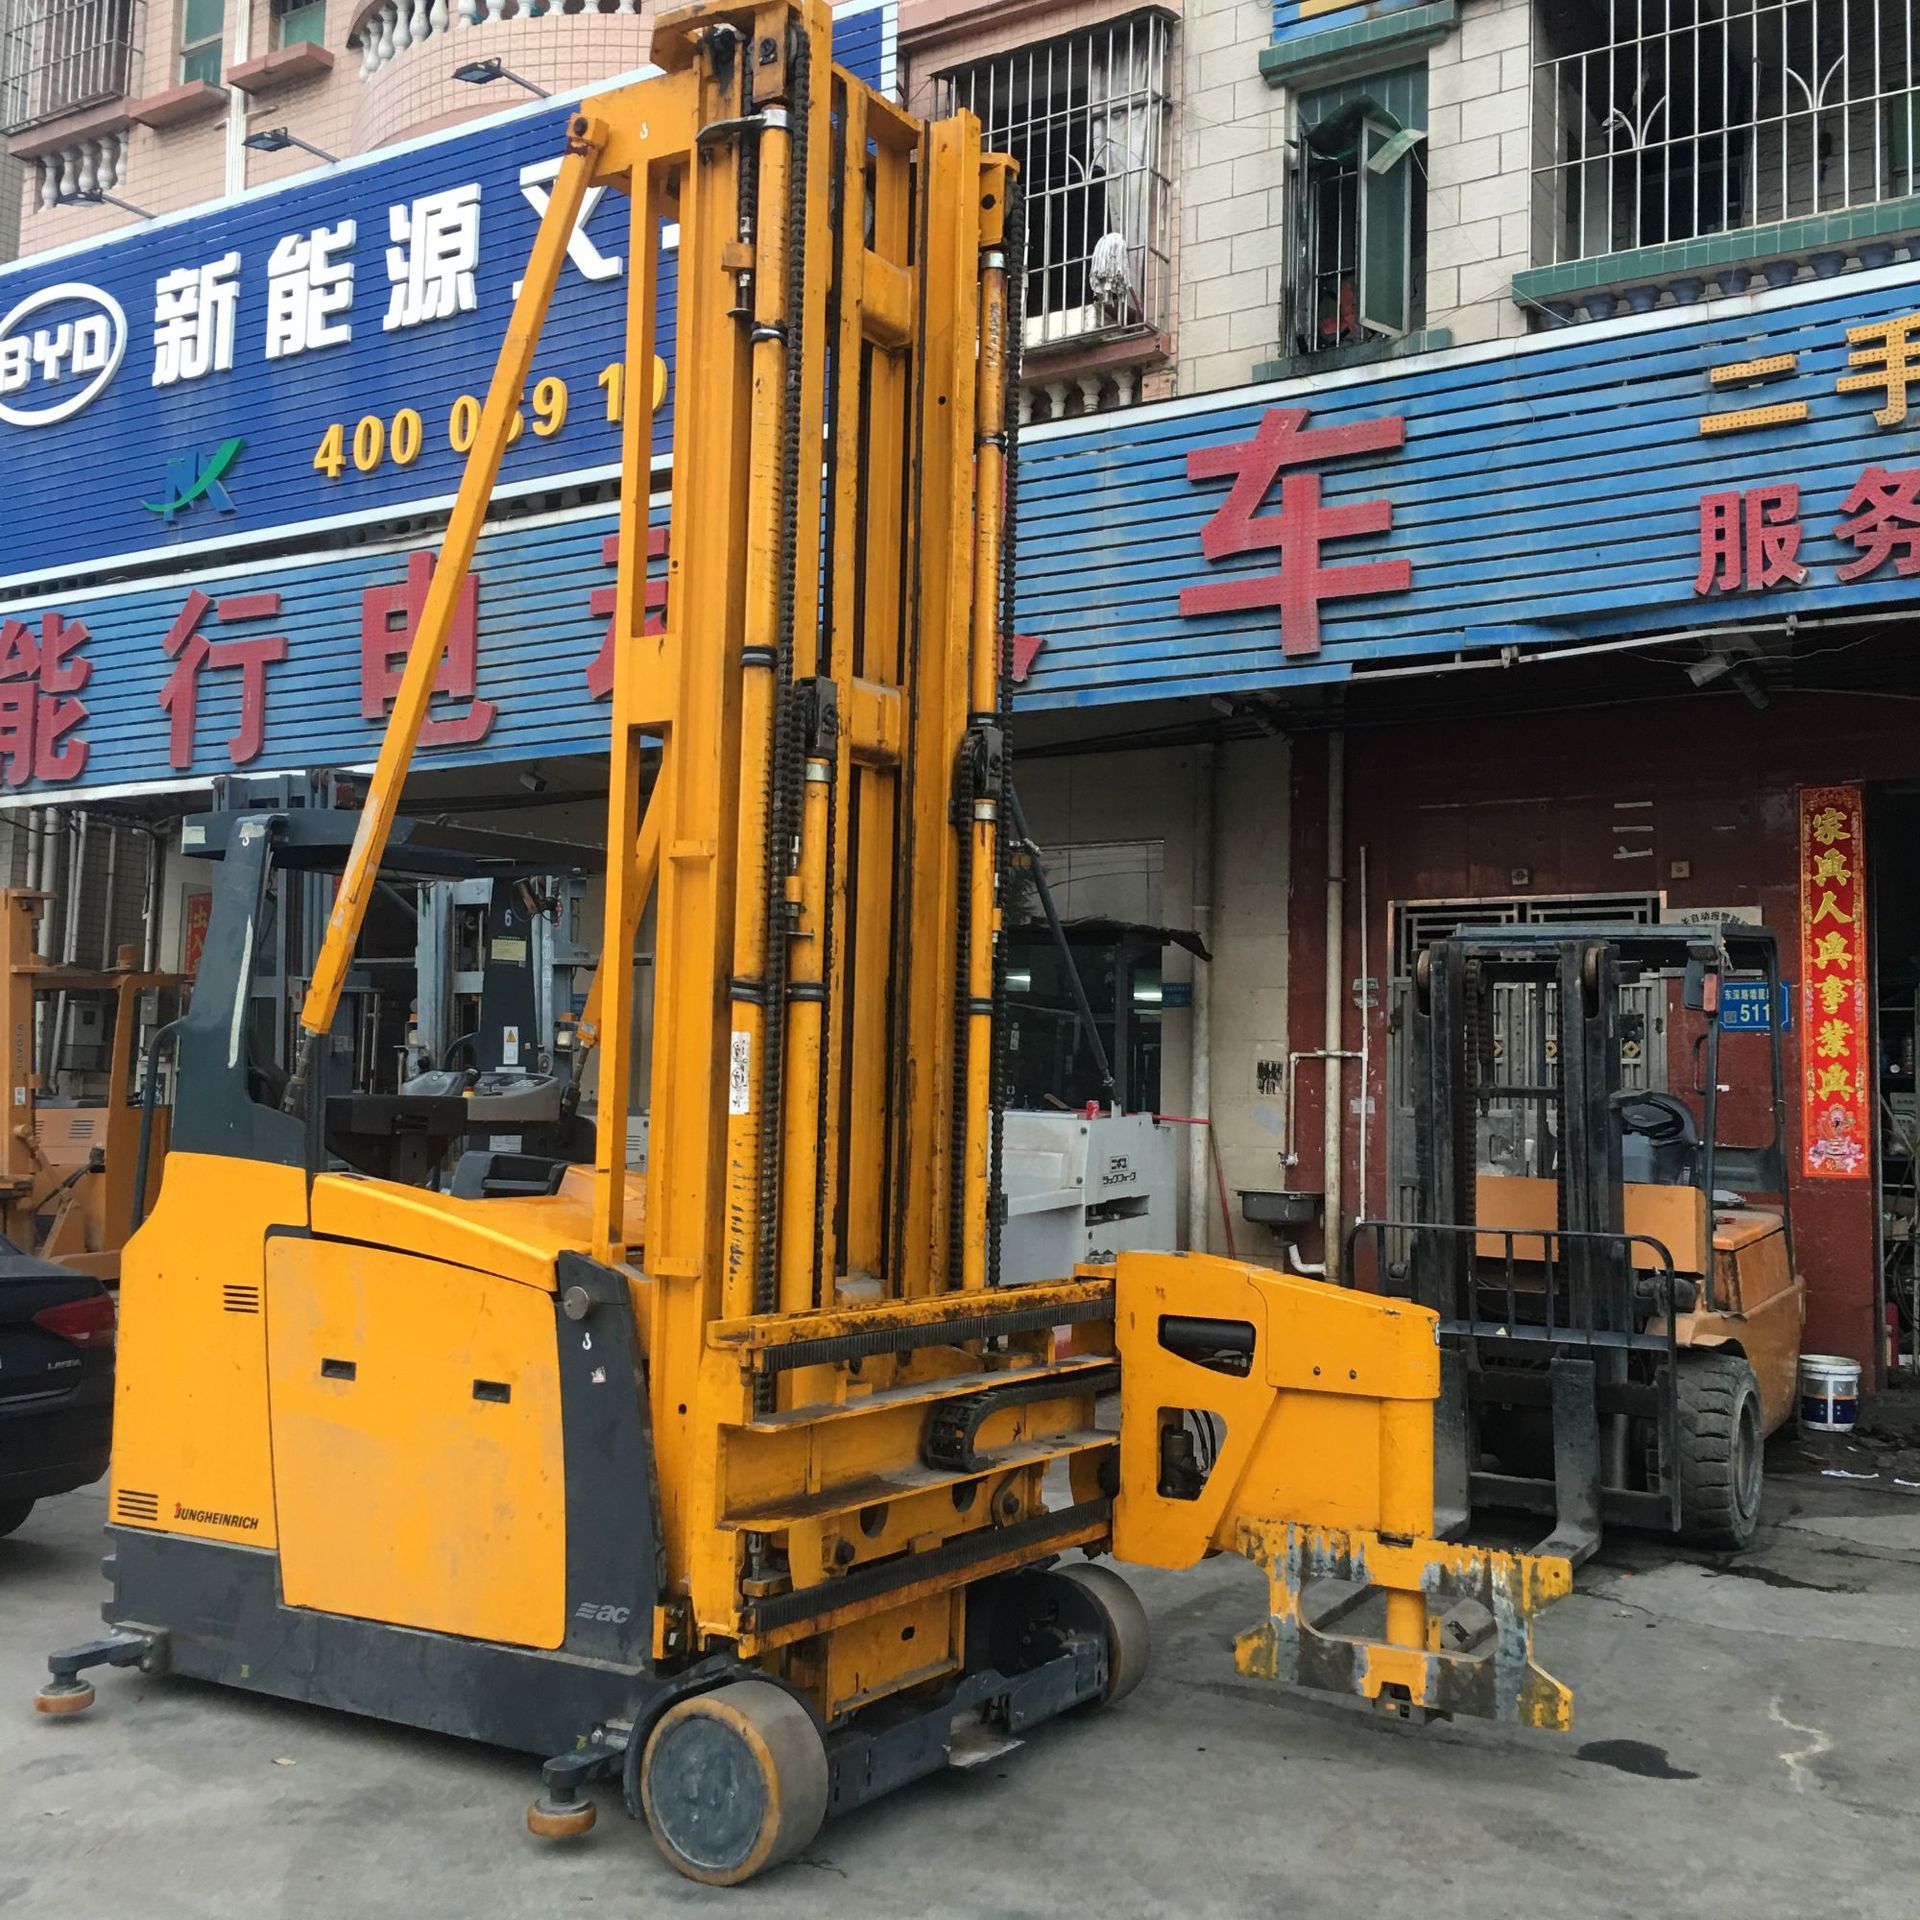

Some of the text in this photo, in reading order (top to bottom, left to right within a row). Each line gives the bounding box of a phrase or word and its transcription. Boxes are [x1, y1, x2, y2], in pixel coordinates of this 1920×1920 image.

[0, 314, 111, 394] BYD
[313, 407, 423, 478] 400
[1693, 466, 1920, 596] 服务
[504, 908, 513, 927] 6
[1740, 1003, 1770, 1022] 511
[174, 1505, 259, 1530] JUNGHEINRICH
